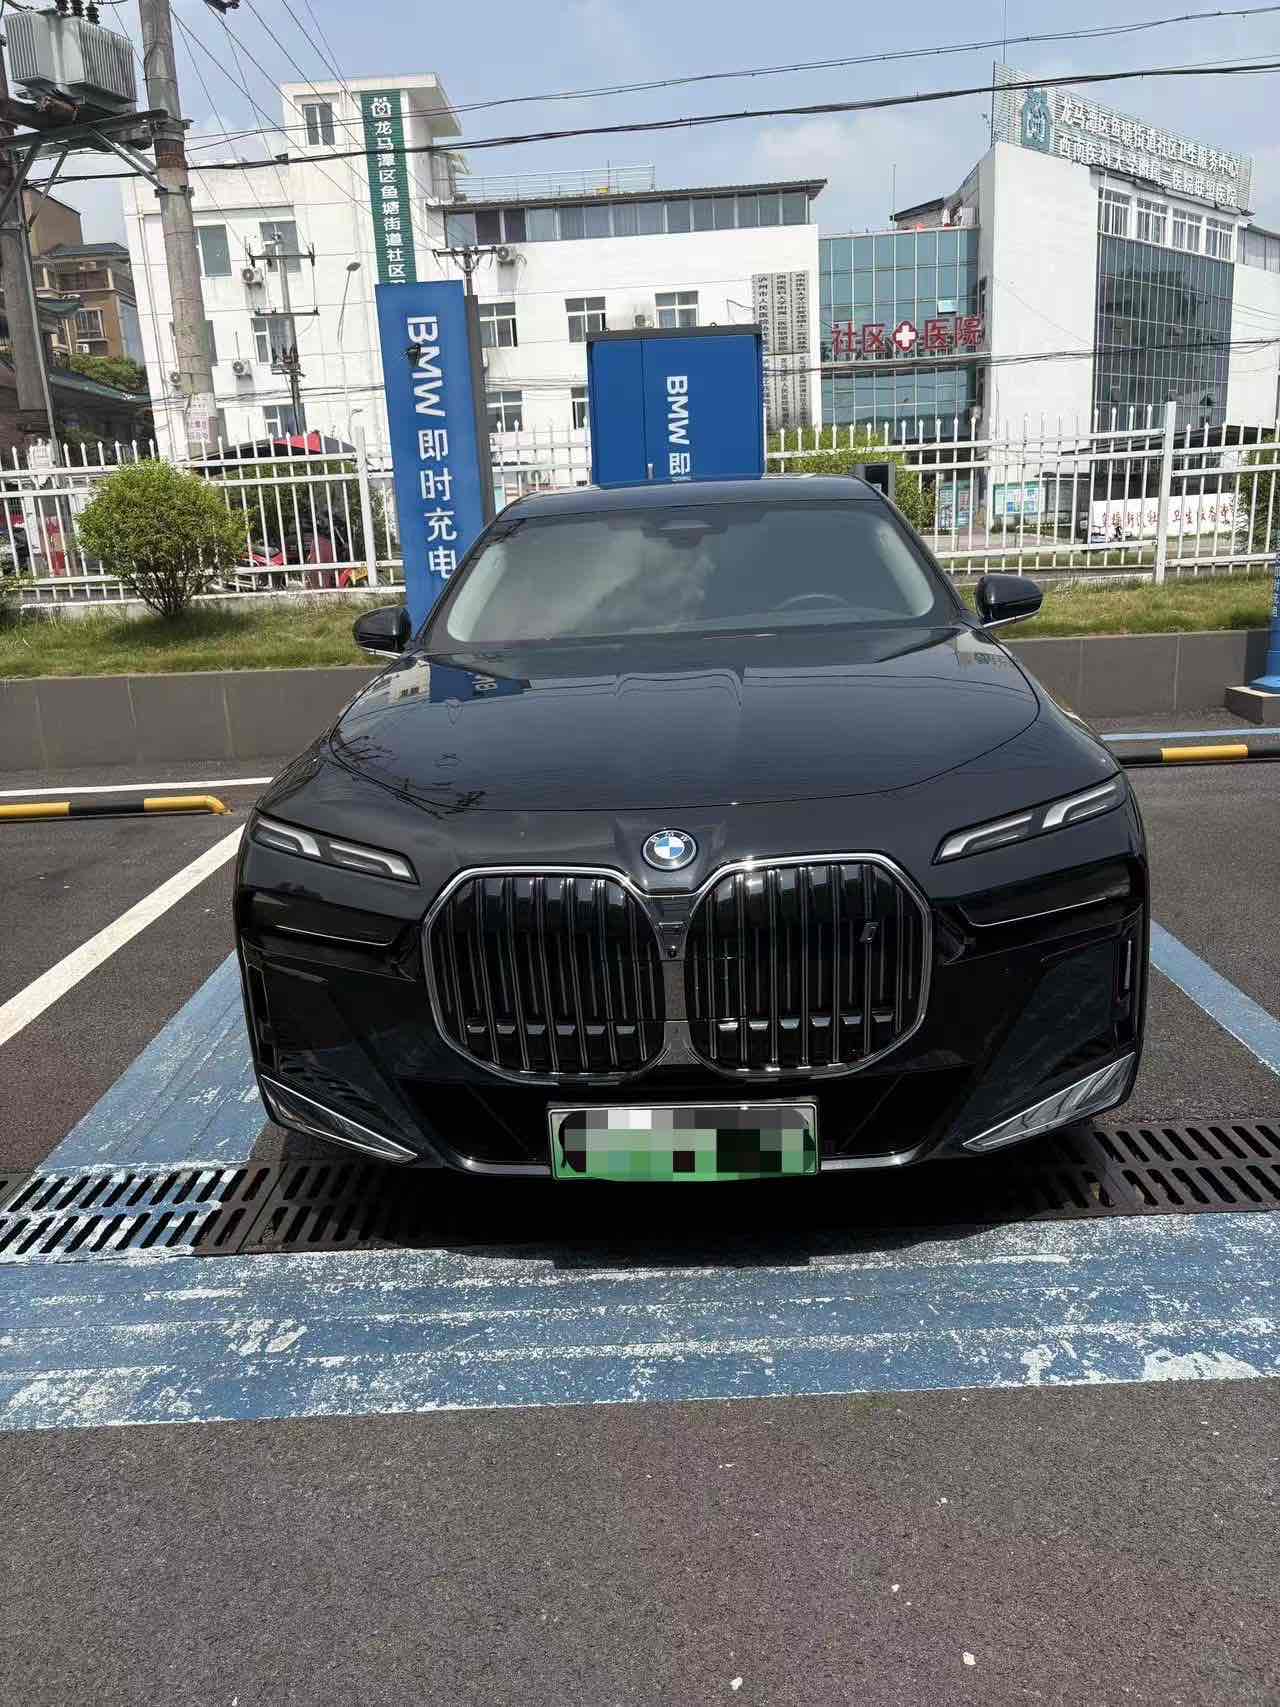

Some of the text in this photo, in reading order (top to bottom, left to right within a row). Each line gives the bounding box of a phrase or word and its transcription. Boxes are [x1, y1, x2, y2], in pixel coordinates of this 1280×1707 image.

[374, 121, 407, 284] 龙马潭区鱼塘街道社区
[832, 315, 984, 352] 社区 医院
[407, 316, 457, 580] BMW 即时充电
[666, 375, 691, 480] BMW 即
[649, 831, 690, 843] BMW
